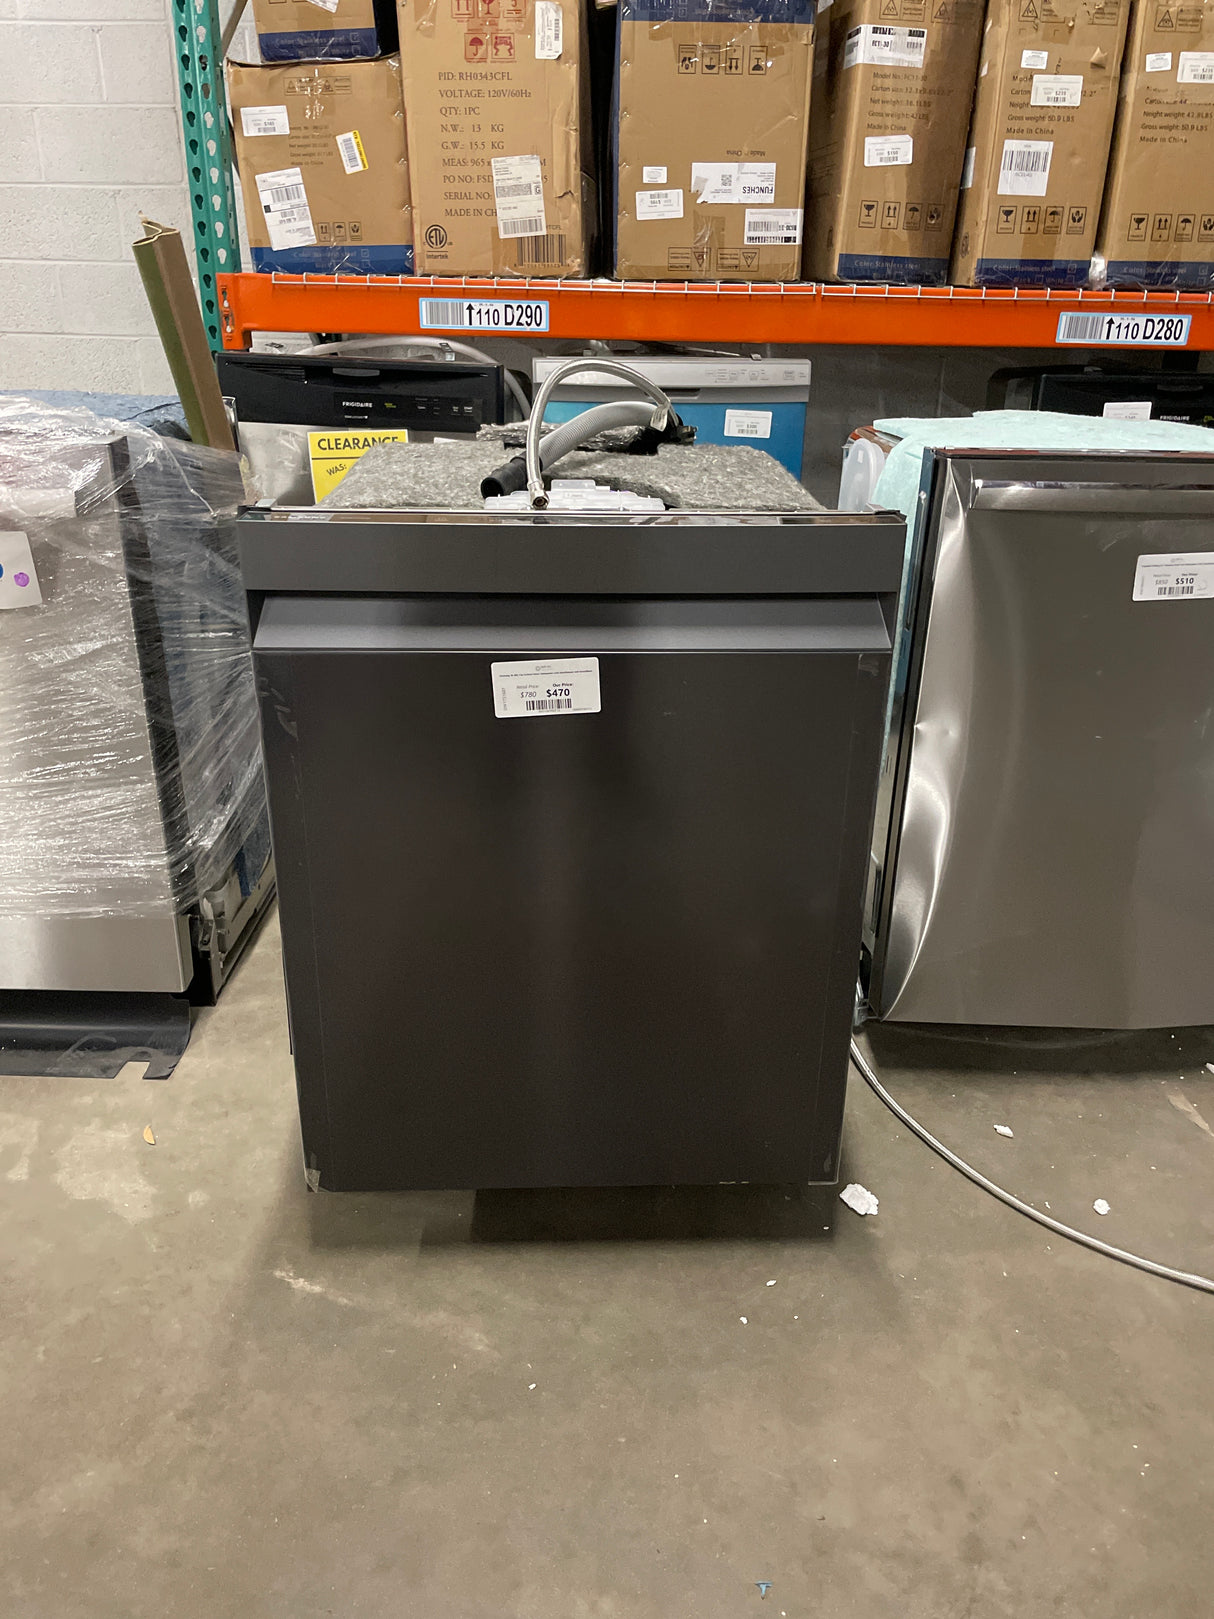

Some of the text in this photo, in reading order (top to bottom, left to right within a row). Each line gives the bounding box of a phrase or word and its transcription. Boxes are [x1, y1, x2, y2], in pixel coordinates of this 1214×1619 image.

[438, 71, 513, 81] PID: RH0343CFL
[438, 89, 532, 98] VOLTAGE: 120V/60Hz
[439, 106, 481, 117] QTY: 1PC
[471, 123, 482, 133] 13
[490, 123, 505, 133] KG
[1006, 127, 1055, 135] Made in China
[1168, 136, 1188, 144] China
[470, 141, 486, 150] 15.5
[491, 141, 505, 150] KG
[442, 158, 469, 167] MEAS:
[470, 158, 486, 167] 965
[443, 174, 456, 184] PO
[457, 174, 475, 184] NO:
[742, 186, 774, 194] FUNCHES
[443, 191, 492, 201] SERIAL NO:
[444, 208, 471, 217] MADE
[472, 208, 483, 217] IN
[476, 304, 543, 327] 110 D290
[1115, 318, 1184, 341] 110 D280
[326, 463, 348, 476] WAS:
[1175, 577, 1195, 585] $510
[520, 688, 570, 699] $780 $470
